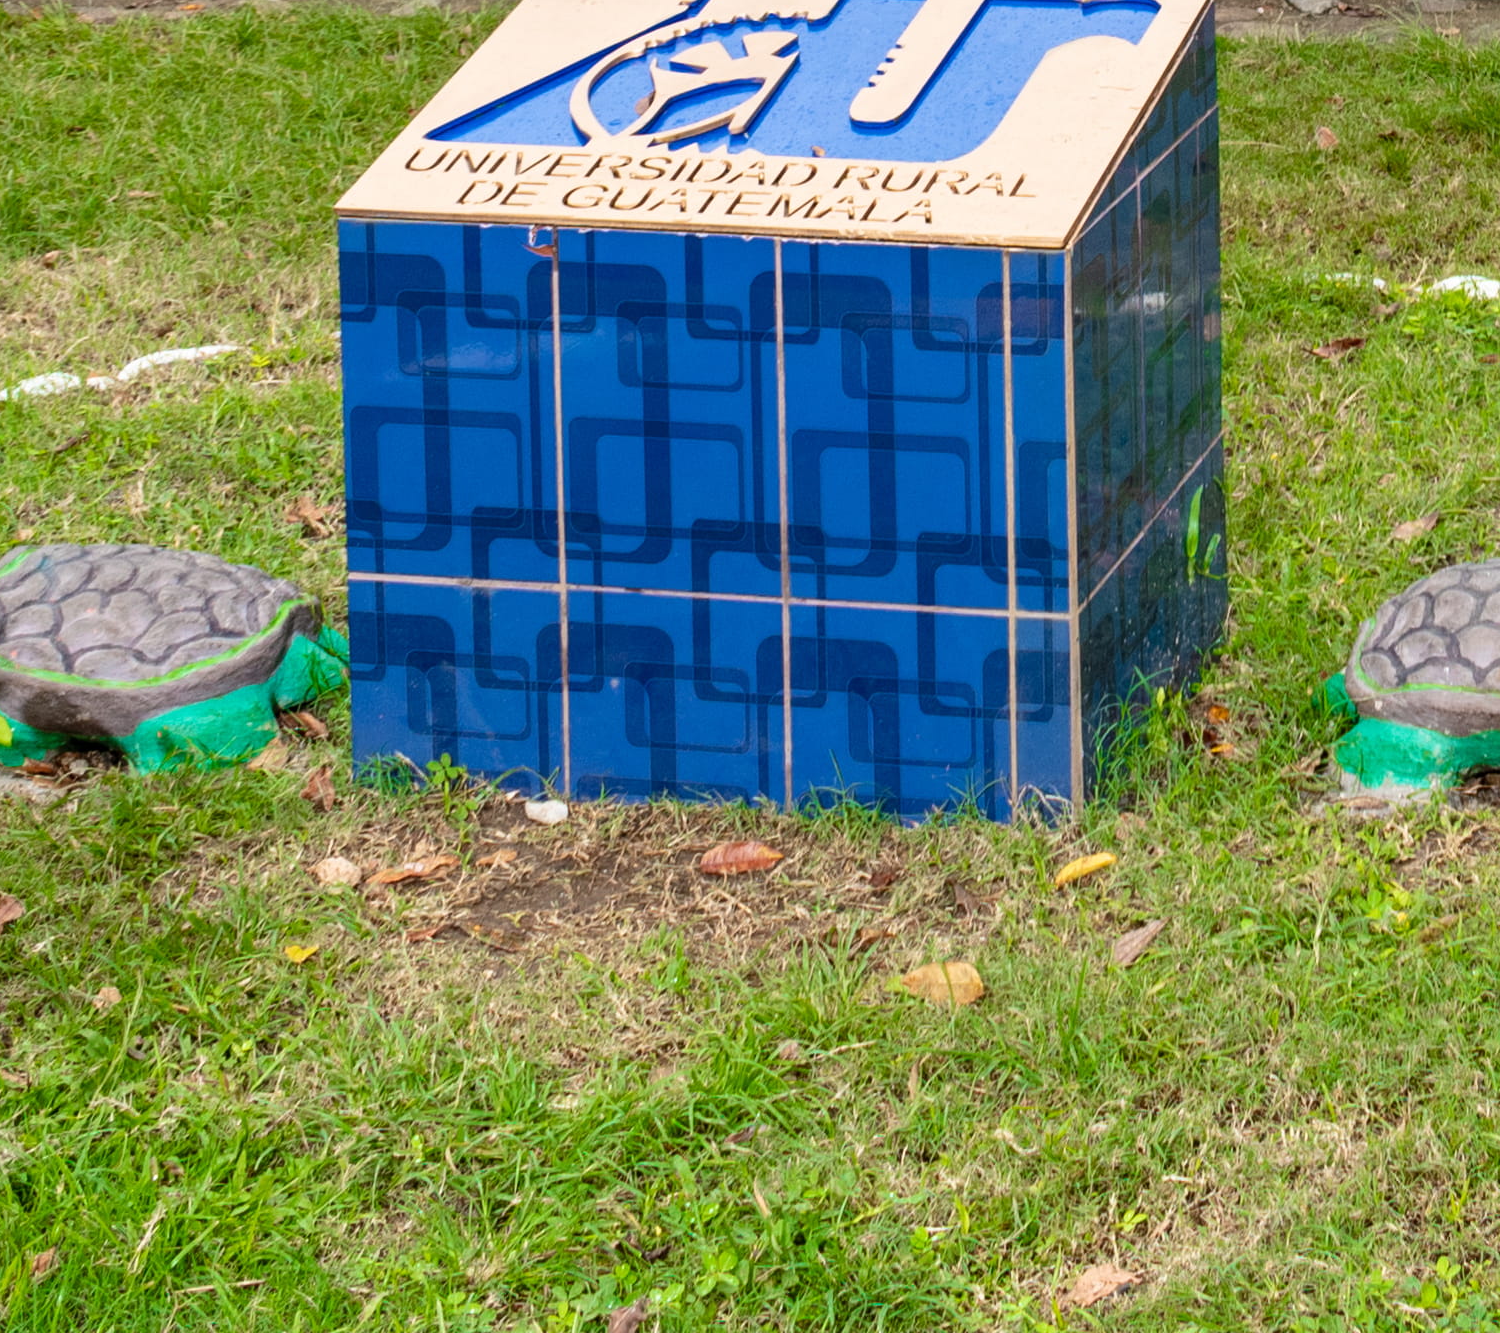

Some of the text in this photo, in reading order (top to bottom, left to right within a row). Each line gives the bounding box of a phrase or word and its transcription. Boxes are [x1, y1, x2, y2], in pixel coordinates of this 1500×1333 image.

[404, 147, 1038, 198] UNIVERSIDAD RURAL
[456, 180, 933, 225] DE GUATEMALA
